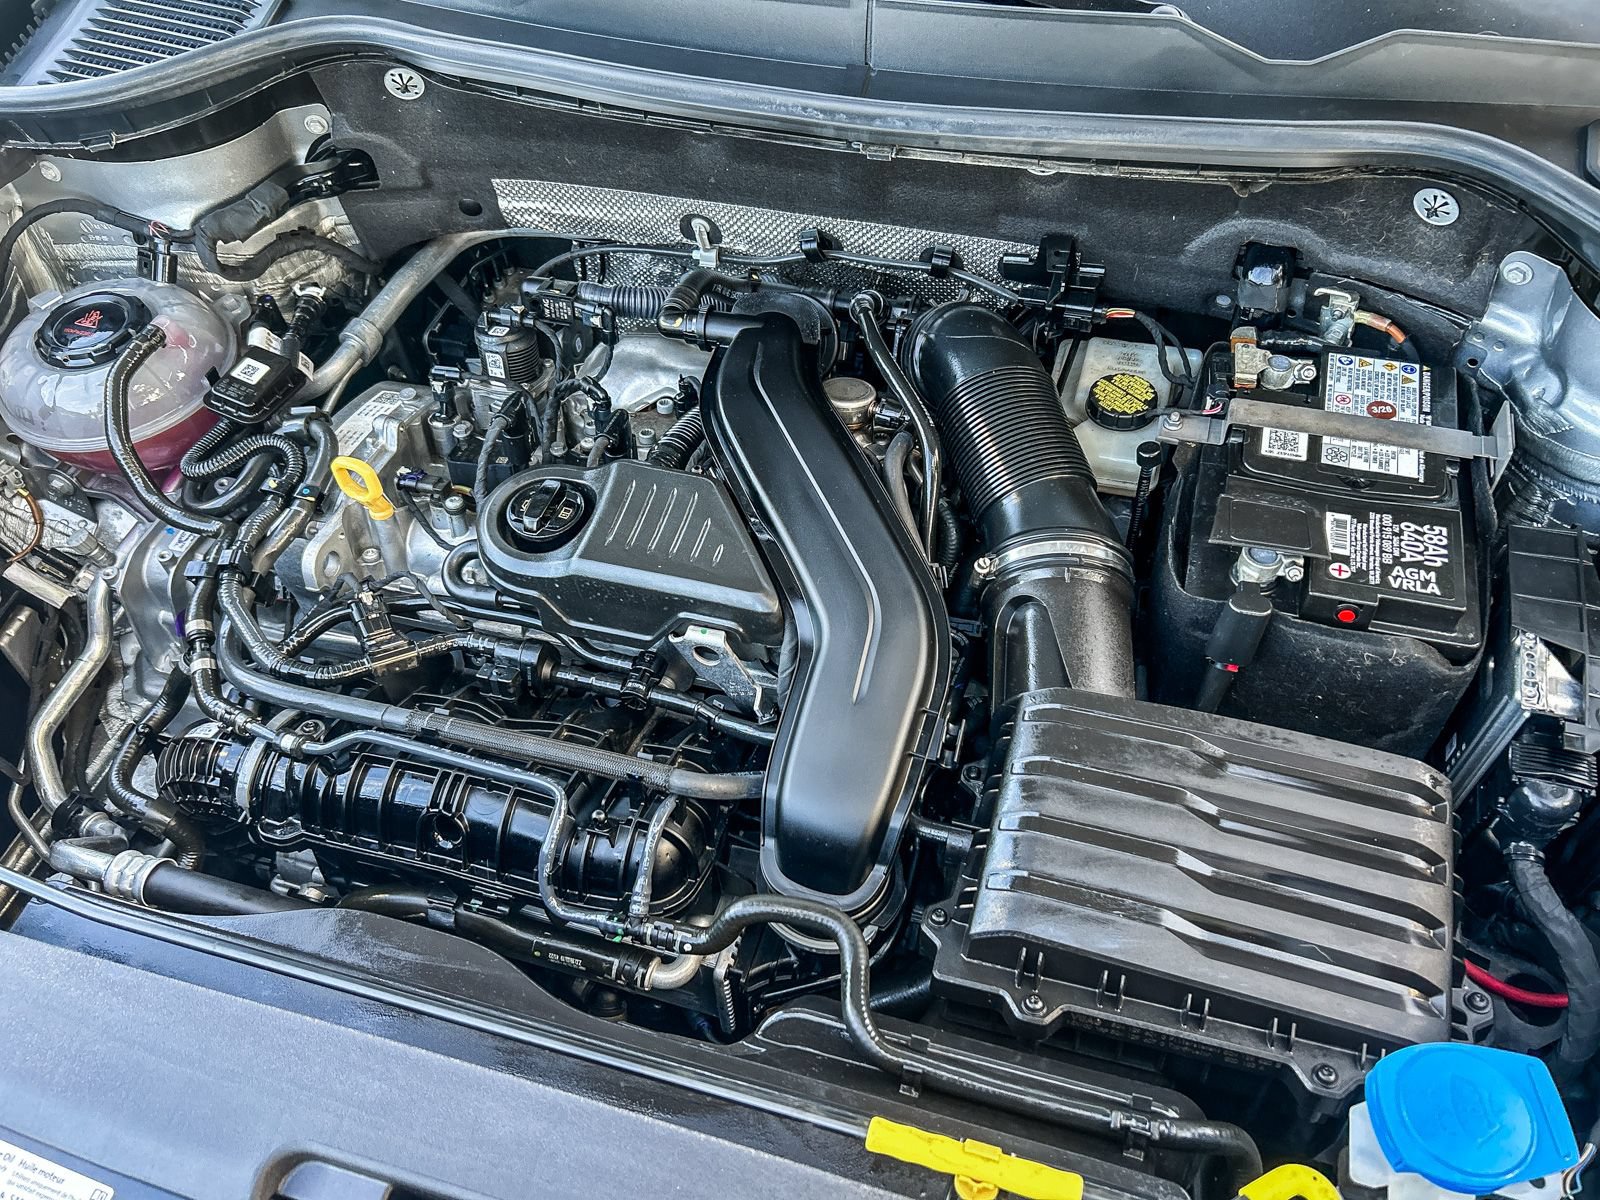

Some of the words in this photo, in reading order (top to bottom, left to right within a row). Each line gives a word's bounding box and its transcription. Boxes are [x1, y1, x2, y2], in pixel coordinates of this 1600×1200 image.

[1382, 514, 1393, 526] 000
[1382, 527, 1393, 539] 915
[1400, 521, 1425, 562] 640A
[1422, 525, 1449, 567] 58Ah
[1391, 565, 1436, 583] AGM
[1387, 575, 1441, 596] VRLA
[18, 1159, 38, 1174] Huile
[38, 1169, 65, 1185] moteur
